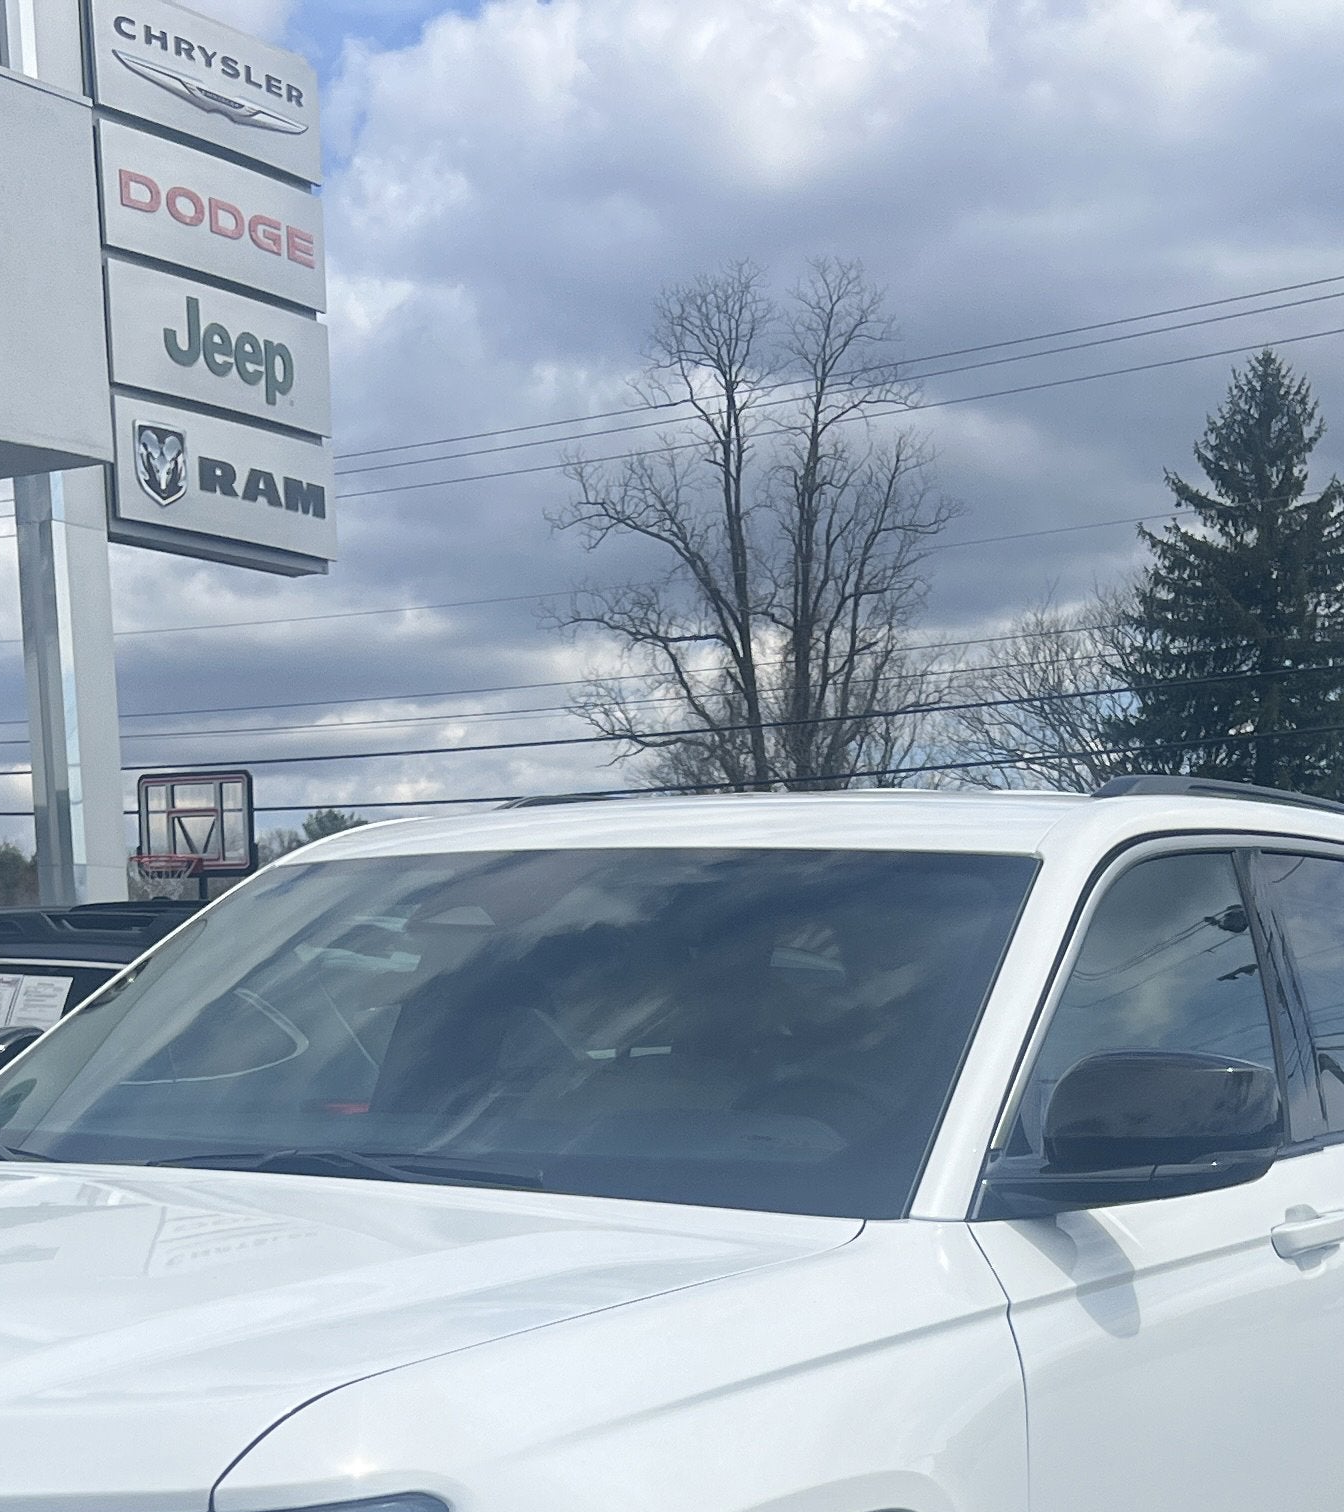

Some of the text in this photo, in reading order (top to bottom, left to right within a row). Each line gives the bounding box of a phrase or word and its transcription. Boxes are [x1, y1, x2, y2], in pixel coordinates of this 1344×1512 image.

[113, 15, 304, 108] CHRYSLER
[118, 168, 315, 269] DODGE
[163, 295, 294, 406] Jeep
[198, 455, 326, 520] RAM
